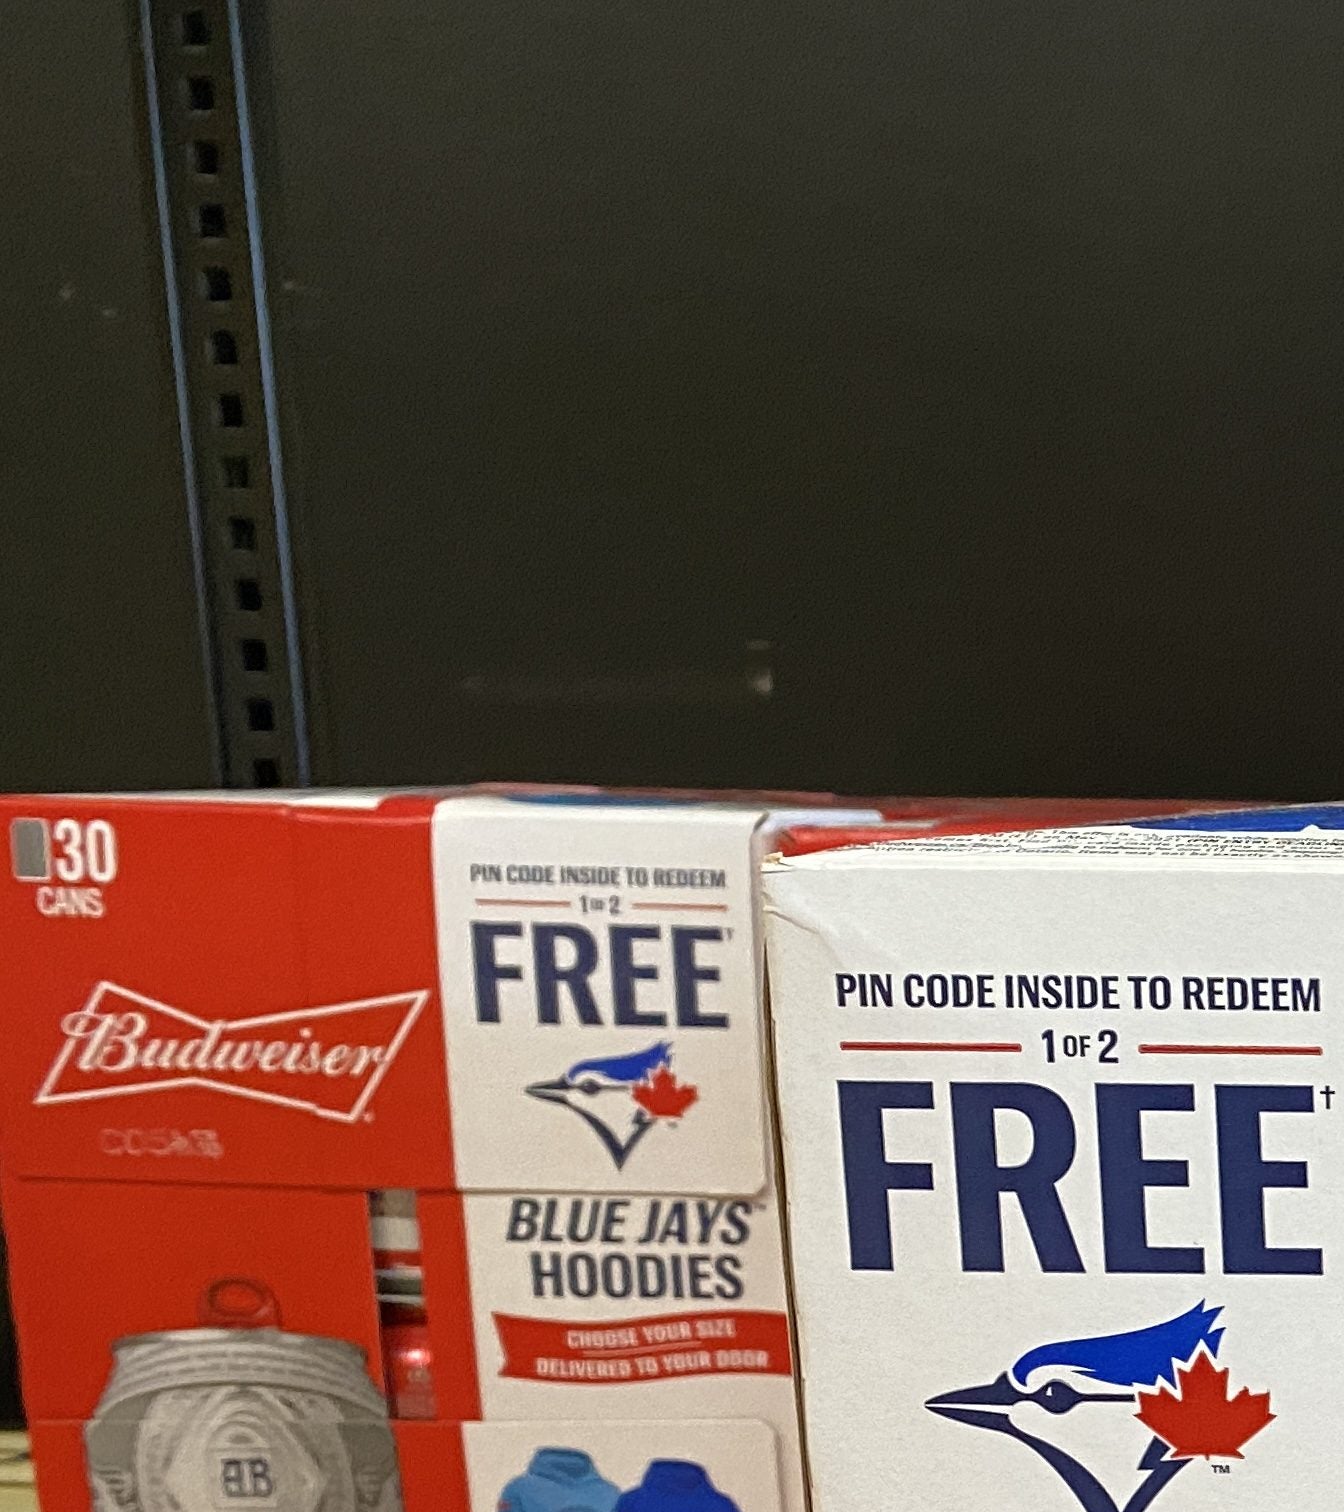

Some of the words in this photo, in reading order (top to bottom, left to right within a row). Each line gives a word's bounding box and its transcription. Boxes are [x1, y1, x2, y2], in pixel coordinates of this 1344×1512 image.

[52, 818, 115, 882] 30
[470, 863, 500, 884] PIN
[506, 864, 553, 885] CODE
[560, 865, 620, 886] INSIDE
[625, 866, 648, 887] TO
[654, 868, 725, 889] REDEEM
[37, 888, 104, 917] CANS
[470, 921, 731, 1029] FREE
[836, 973, 894, 1008] PIN
[903, 974, 996, 1009] CODE
[1004, 975, 1121, 1010] INSIDE
[1127, 976, 1173, 1011] TO
[1182, 977, 1322, 1012] REDEEM
[61, 1012, 387, 1079] Budweiser
[1041, 1029, 1055, 1063] 1
[1063, 1035, 1091, 1059] OF
[1098, 1030, 1120, 1064] 2
[506, 1200, 632, 1243] BLUE
[531, 1252, 743, 1299] HOODIES
[566, 1324, 636, 1349] CHOOSE
[642, 1321, 692, 1345] YOUR
[697, 1318, 735, 1340] SIZE
[536, 1355, 630, 1381] DELIVERED
[635, 1355, 658, 1379] TO
[662, 1353, 711, 1375] YOUR
[717, 1348, 767, 1370] DOOR
